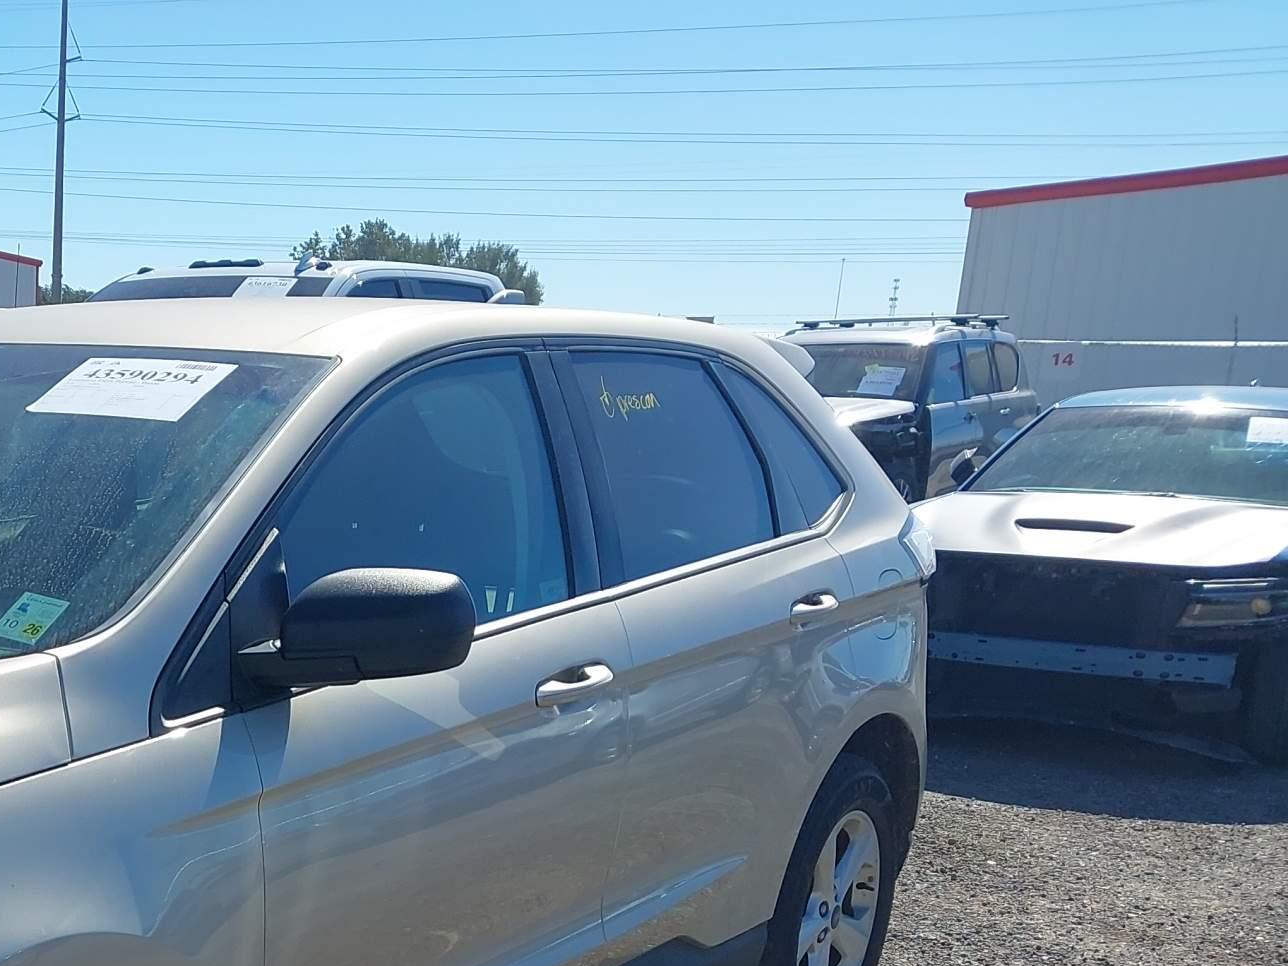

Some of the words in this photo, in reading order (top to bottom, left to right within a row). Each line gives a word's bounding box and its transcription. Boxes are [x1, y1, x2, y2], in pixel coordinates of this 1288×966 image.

[1052, 352, 1075, 367] 14
[83, 368, 204, 385] 43590294
[2, 618, 19, 629] 10
[22, 623, 43, 636] 26
